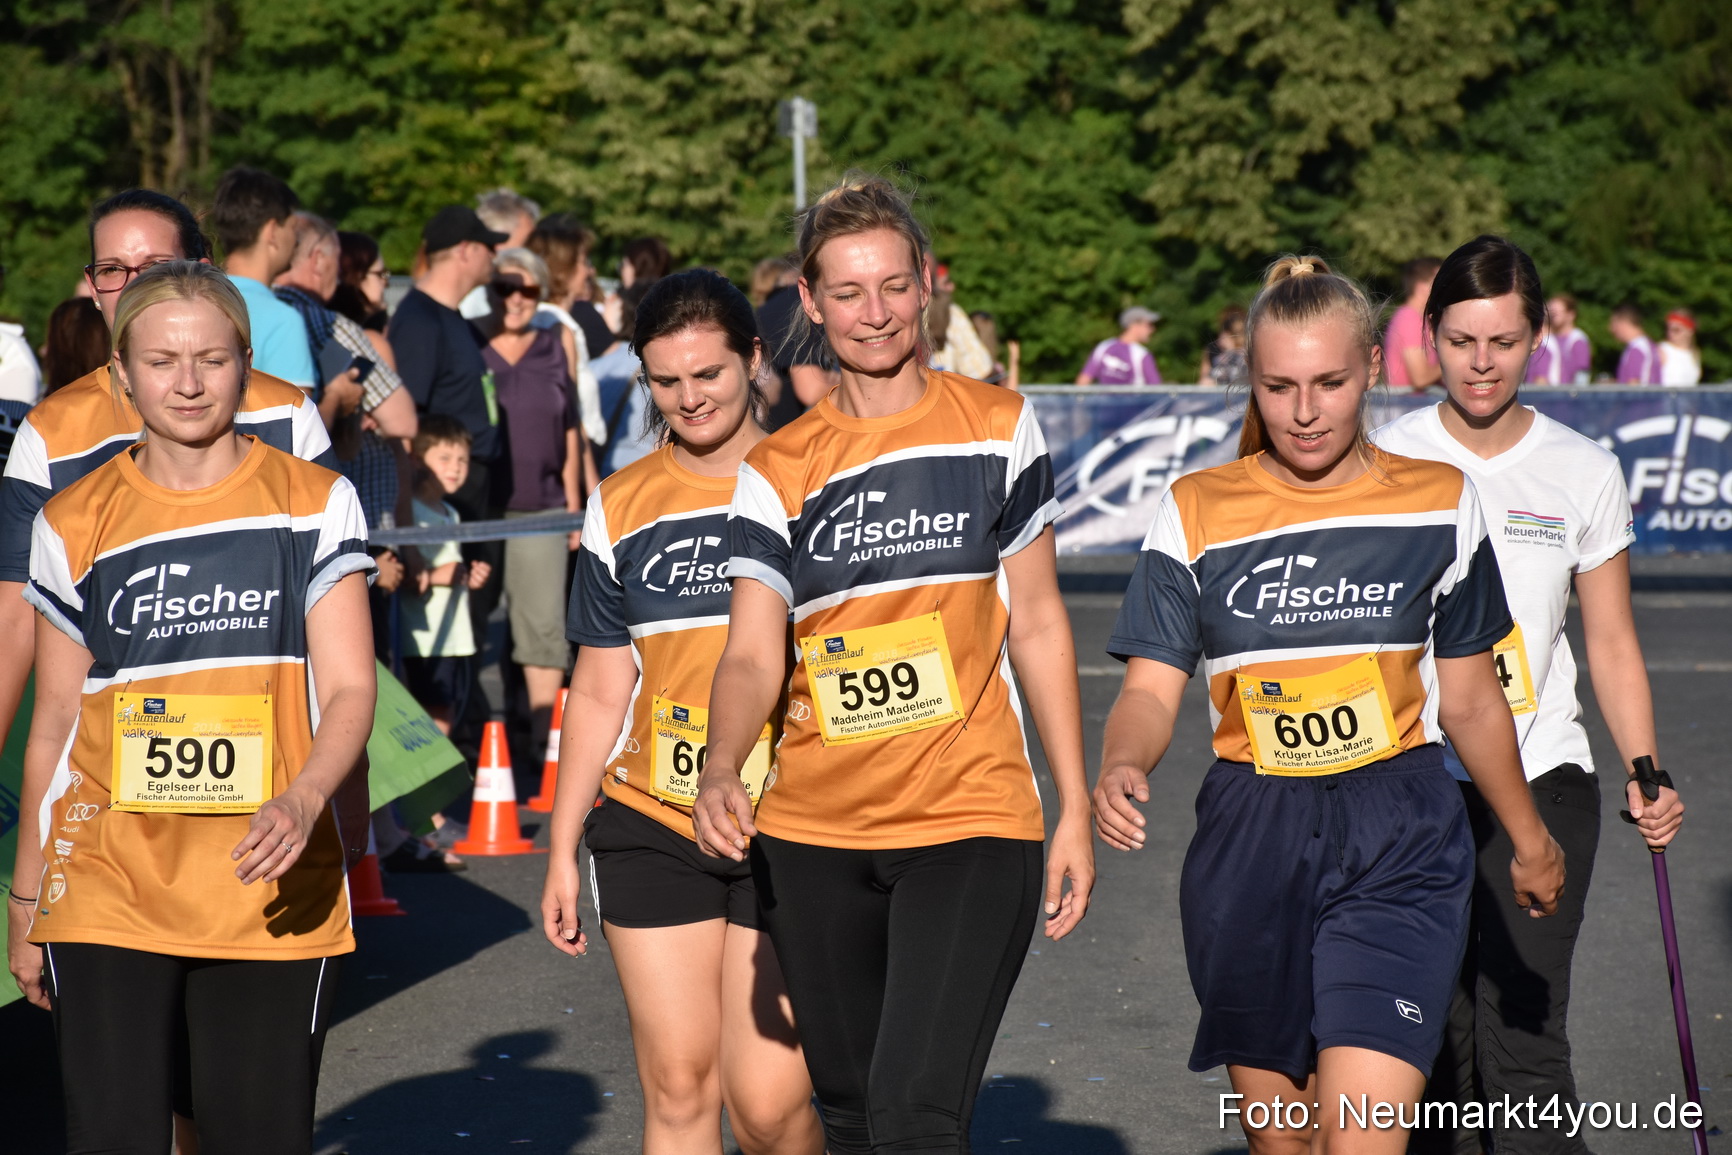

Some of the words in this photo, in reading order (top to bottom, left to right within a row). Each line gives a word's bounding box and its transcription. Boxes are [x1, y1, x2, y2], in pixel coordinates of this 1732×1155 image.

[833, 508, 970, 551] Fischer
[847, 536, 963, 564] AUTOMOBILE
[131, 583, 279, 624] Fischer
[1256, 577, 1404, 610] Fischer
[1269, 606, 1393, 625] AUTOMOBILE
[146, 616, 269, 641] AUTOMOBILE
[819, 646, 865, 662] firmenlauf
[839, 661, 919, 711] 599
[1256, 693, 1302, 702] firmenlauf
[133, 712, 187, 723] firmenlauf
[831, 709, 884, 727] Madeheim
[886, 696, 943, 716] Madeleine
[840, 722, 866, 734] Fischer
[867, 716, 911, 730] Automobile
[912, 708, 936, 721] GmbH
[664, 715, 705, 733] firmenlauf
[1274, 705, 1358, 749] 600
[145, 737, 235, 779] 590
[1276, 759, 1303, 768] Fischer
[1305, 754, 1349, 767] Automobile
[1351, 746, 1374, 759] GmbH
[1315, 736, 1373, 758] Lisa-Marie
[136, 793, 166, 801] Fischer
[168, 793, 216, 802] Automobile
[147, 781, 201, 793] Egelseer
[204, 782, 234, 792] Lena
[666, 784, 689, 797] Fischer
